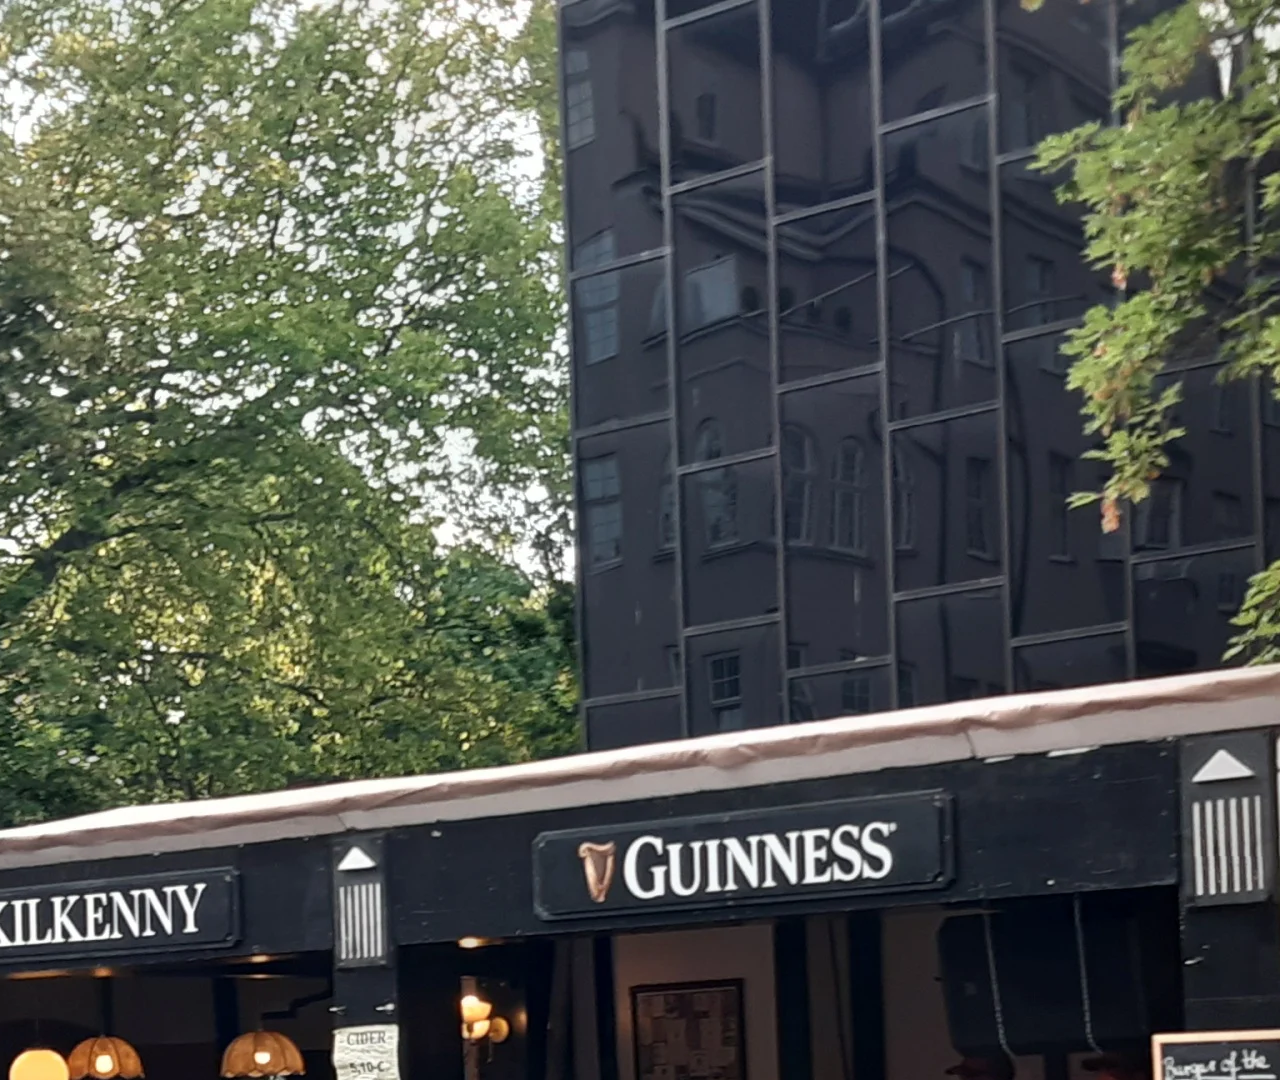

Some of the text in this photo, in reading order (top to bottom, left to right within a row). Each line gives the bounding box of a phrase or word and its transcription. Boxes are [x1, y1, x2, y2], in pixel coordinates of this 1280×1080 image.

[623, 822, 896, 899] GUINNESS
[346, 1030, 387, 1046] CIDER
[1241, 1048, 1271, 1070] the
